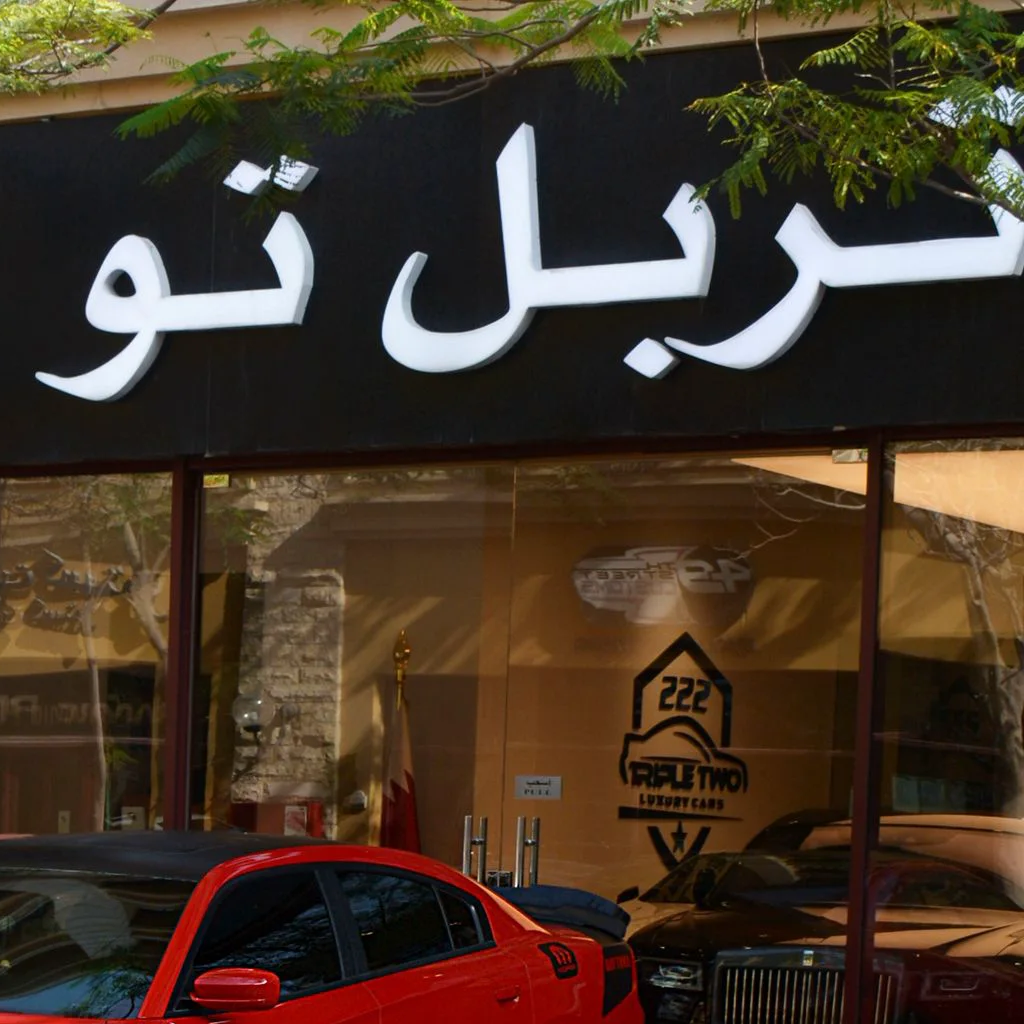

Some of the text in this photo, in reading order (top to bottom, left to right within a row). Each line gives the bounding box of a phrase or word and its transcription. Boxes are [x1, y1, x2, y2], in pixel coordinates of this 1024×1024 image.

[34, 155, 318, 402] تو
[658, 675, 711, 714] 222
[629, 760, 743, 793] TRIPLE TWO
[639, 793, 724, 811] LUXURY CARS
